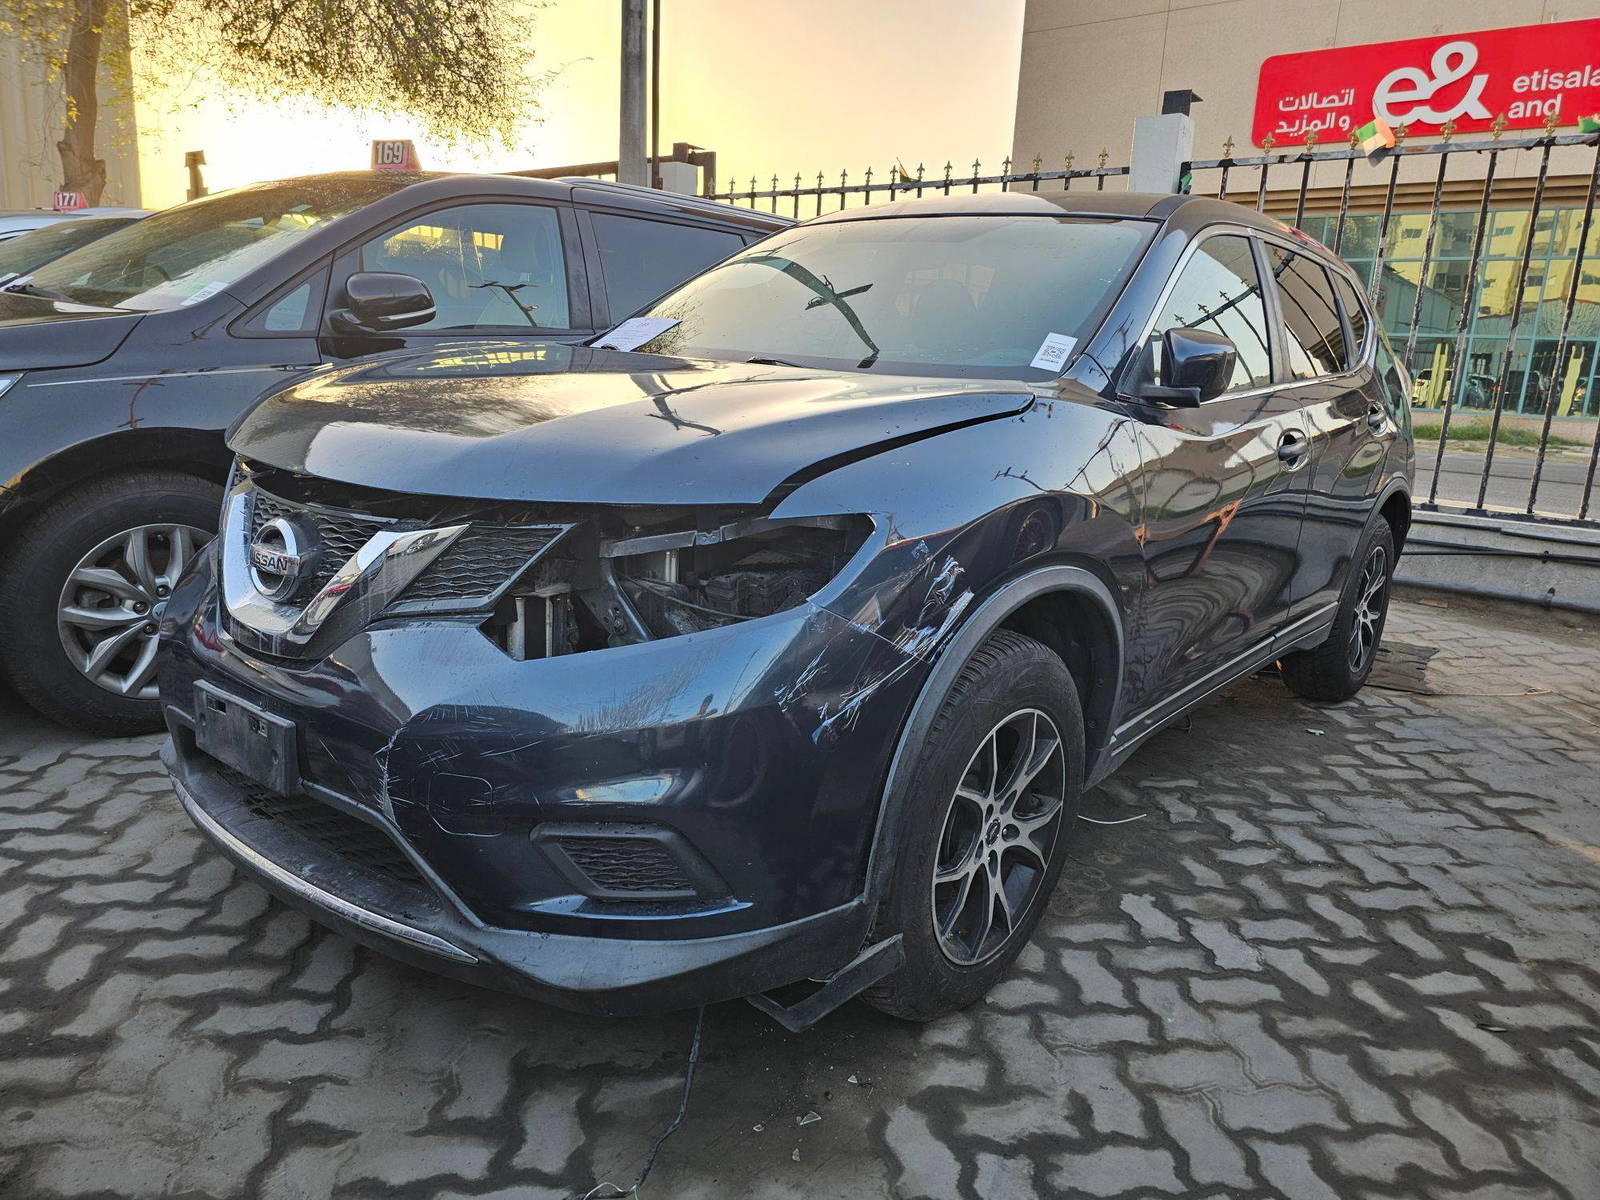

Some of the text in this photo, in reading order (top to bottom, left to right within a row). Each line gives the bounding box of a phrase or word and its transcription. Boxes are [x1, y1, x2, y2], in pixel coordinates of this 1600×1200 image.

[1278, 88, 1355, 111] اتصالات
[1508, 93, 1562, 119] and
[376, 142, 403, 164] 169
[57, 192, 76, 207] 177
[250, 551, 288, 571] ISSAN
